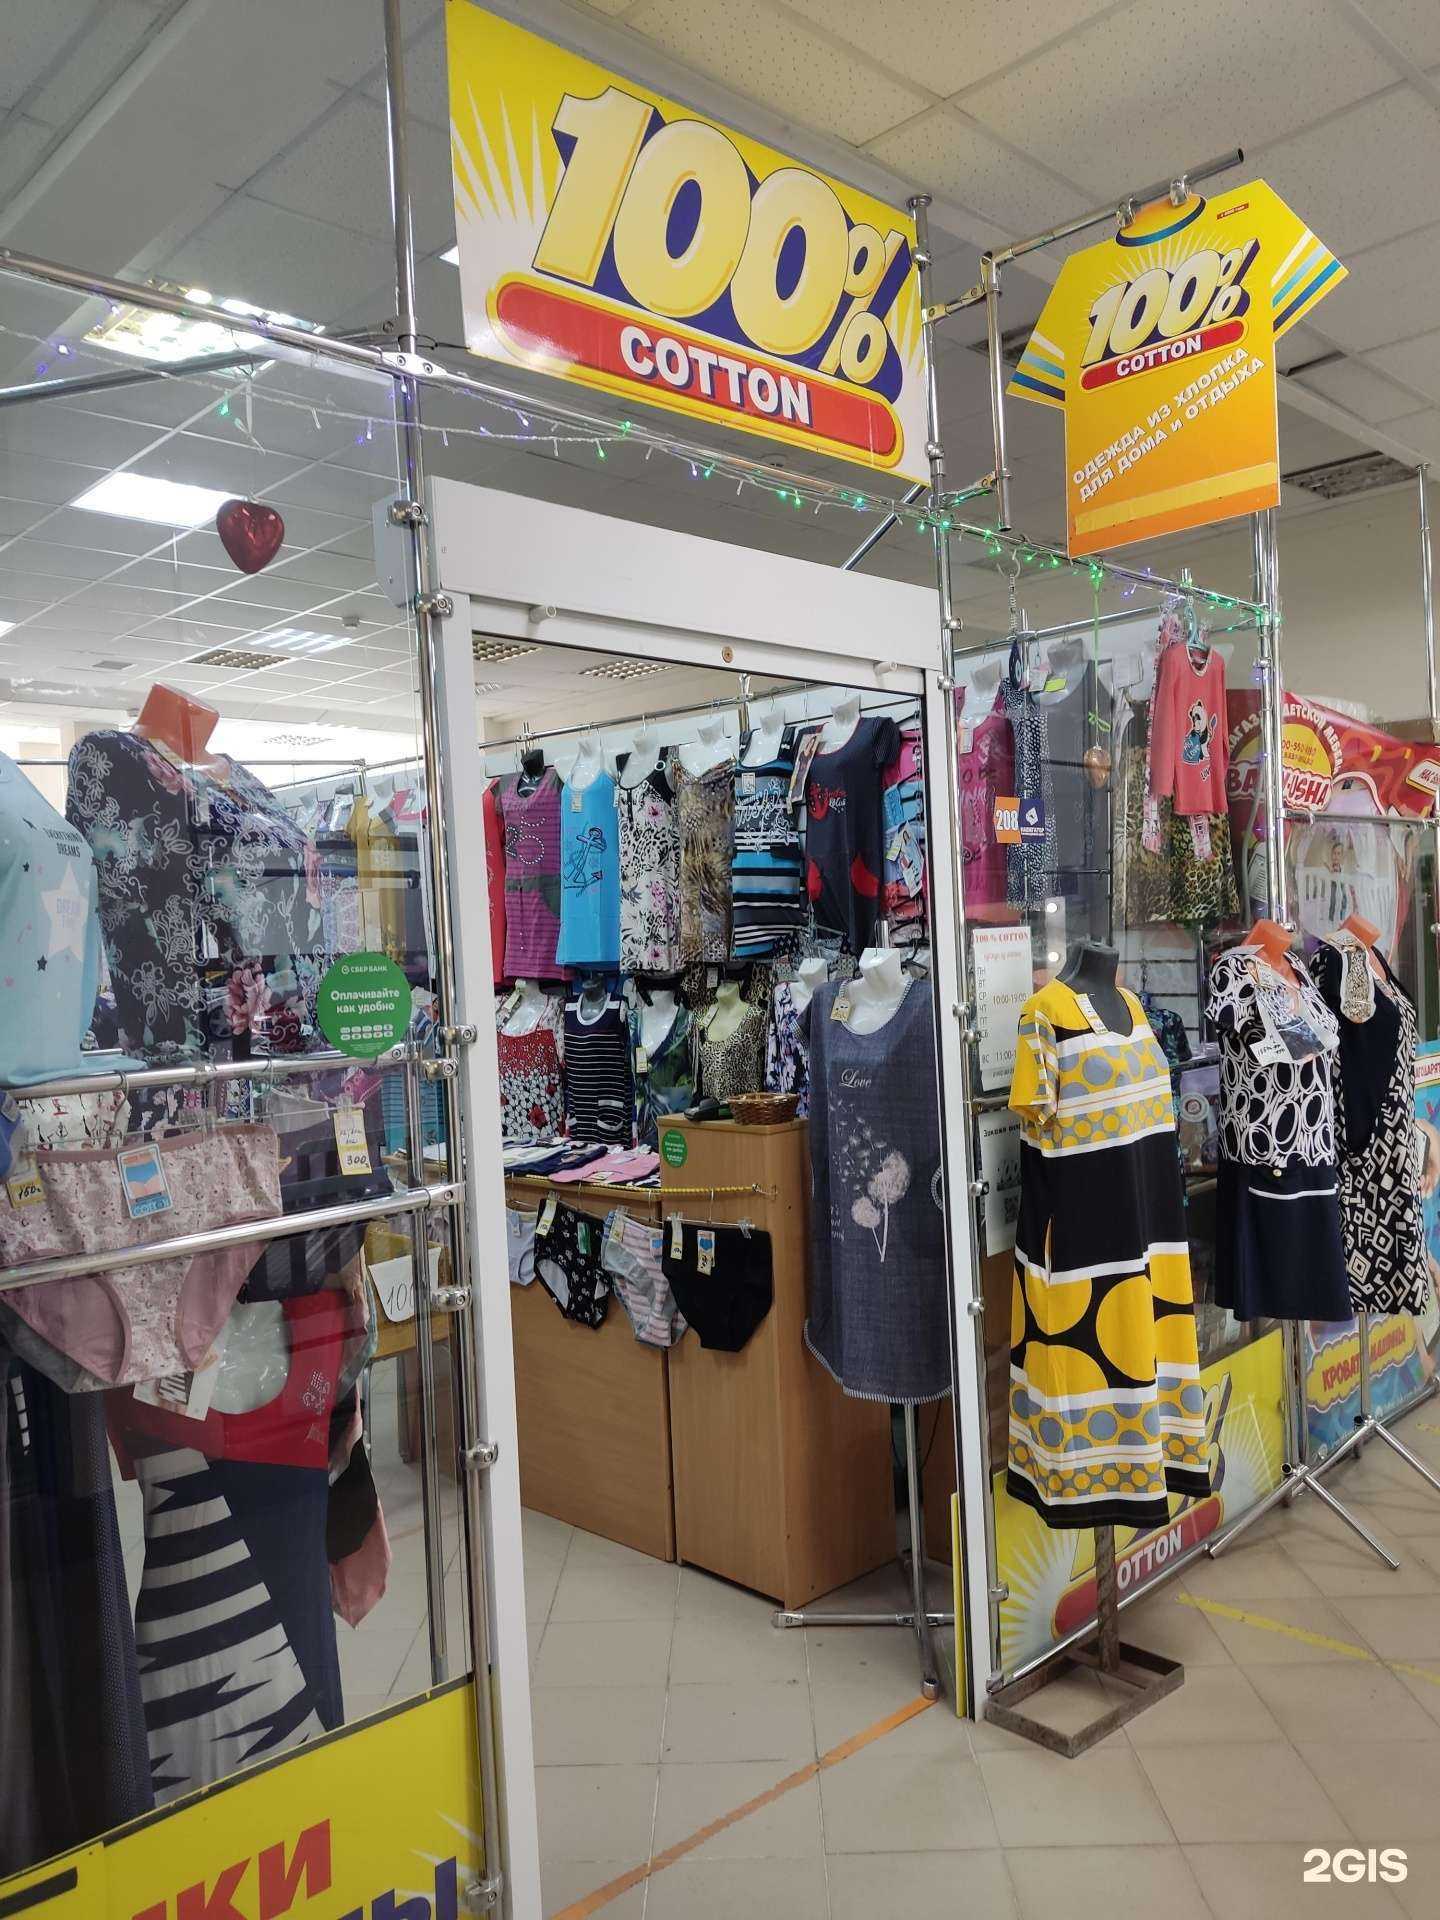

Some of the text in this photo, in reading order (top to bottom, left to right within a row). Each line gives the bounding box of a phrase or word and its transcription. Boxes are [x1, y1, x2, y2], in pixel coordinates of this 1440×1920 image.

[532, 85, 911, 390] 100%
[1080, 238, 1260, 368] 100%
[620, 325, 812, 426] COTTON
[1116, 335, 1202, 376] COTTON
[1073, 347, 1248, 484] ОДЕЖДА ИЗ ХЛОПКА
[1079, 465, 1114, 503] ДЛЯ
[1117, 429, 1168, 474] ДОМА
[1185, 357, 1264, 420] ОТДЫХА
[995, 809, 1019, 831] 208
[330, 987, 400, 1000] Оплачивайте
[336, 1001, 395, 1014] как удобно
[979, 992, 987, 1001] СР
[1322, 1352, 1361, 1393] КРОВАТ
[1116, 1525, 1183, 1591] OTTON
